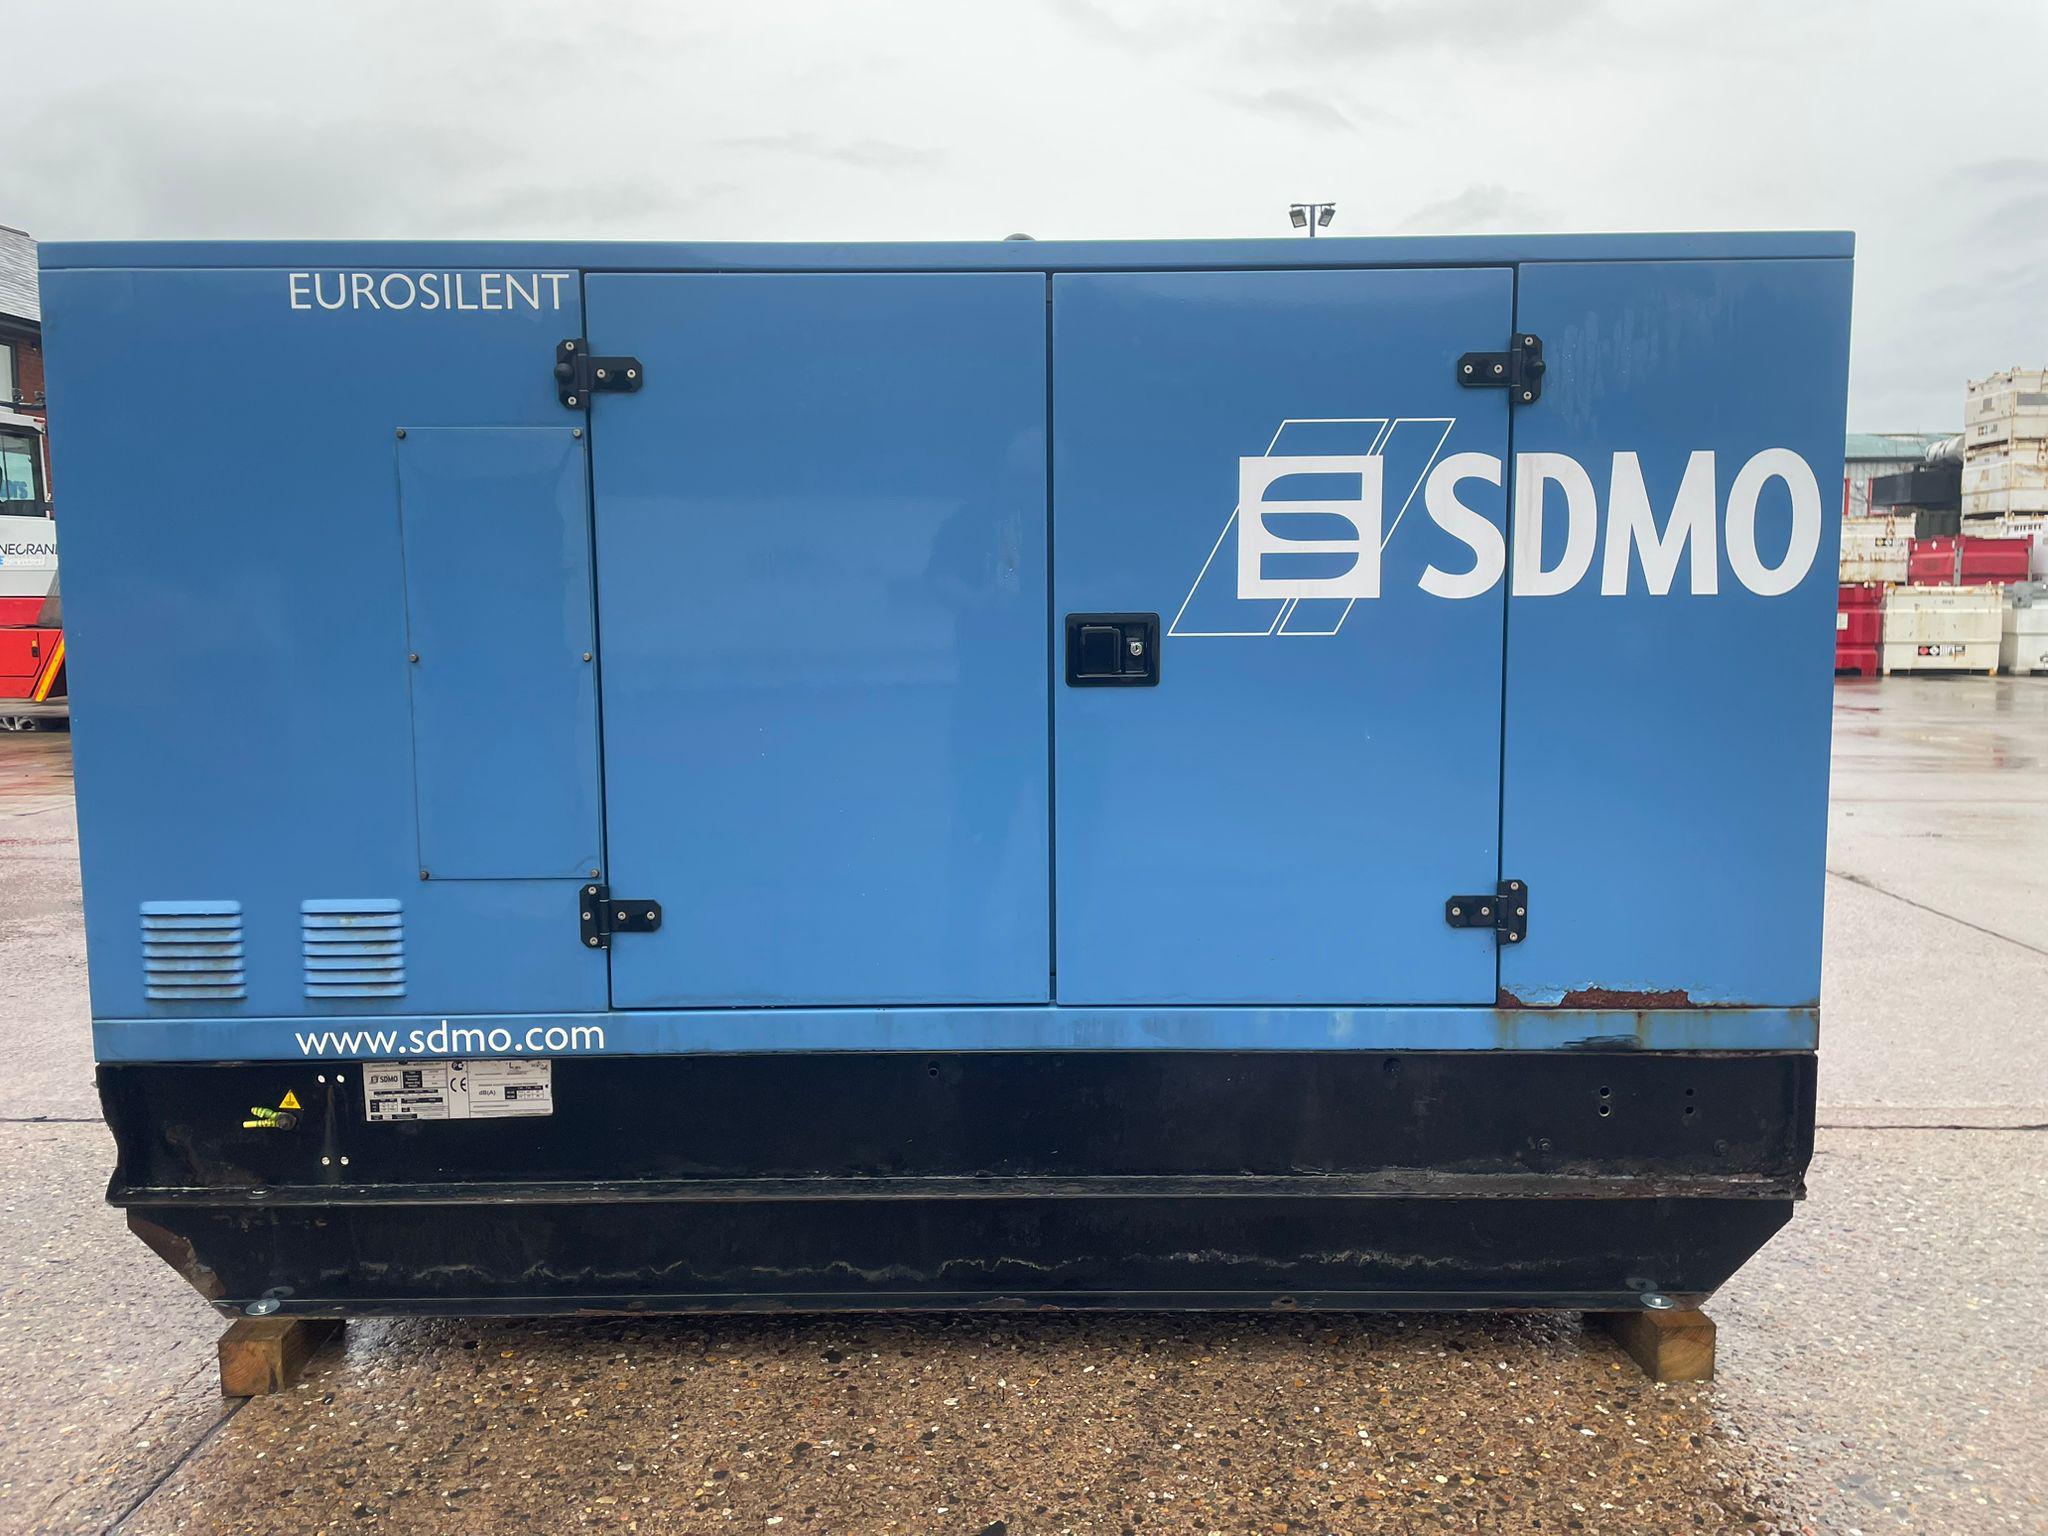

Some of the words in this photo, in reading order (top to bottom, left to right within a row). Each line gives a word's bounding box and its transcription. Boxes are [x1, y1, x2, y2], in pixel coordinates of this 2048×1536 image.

[288, 272, 570, 310] EUROSILENT
[1417, 447, 1823, 600] SDMO
[294, 1019, 605, 1056] www.sdmo.com
[379, 1075, 399, 1083] SDMO
